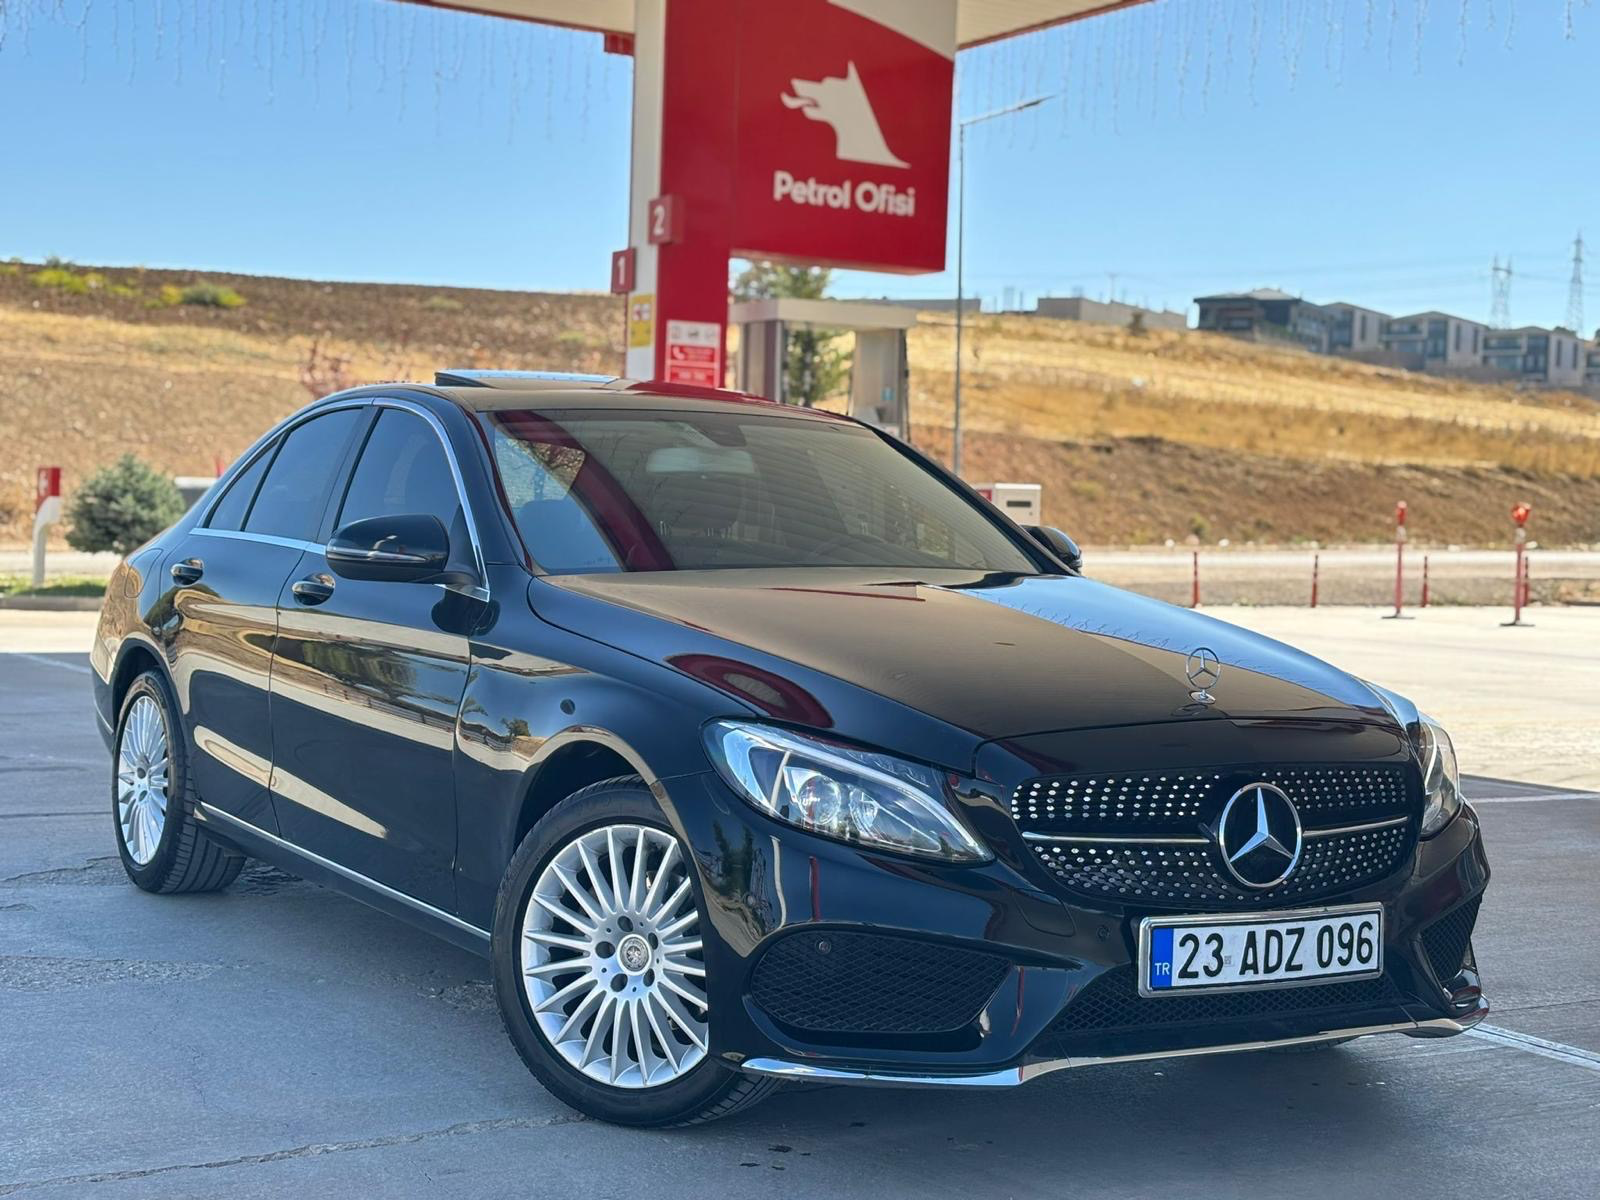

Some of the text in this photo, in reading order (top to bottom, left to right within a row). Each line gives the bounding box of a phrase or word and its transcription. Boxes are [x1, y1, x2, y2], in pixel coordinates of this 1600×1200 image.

[773, 169, 916, 217] Petrol Ofisi
[653, 204, 666, 236] 2
[618, 255, 626, 285] 1
[1177, 921, 1374, 979] 23 ADZ 096
[1154, 962, 1171, 976] TR
